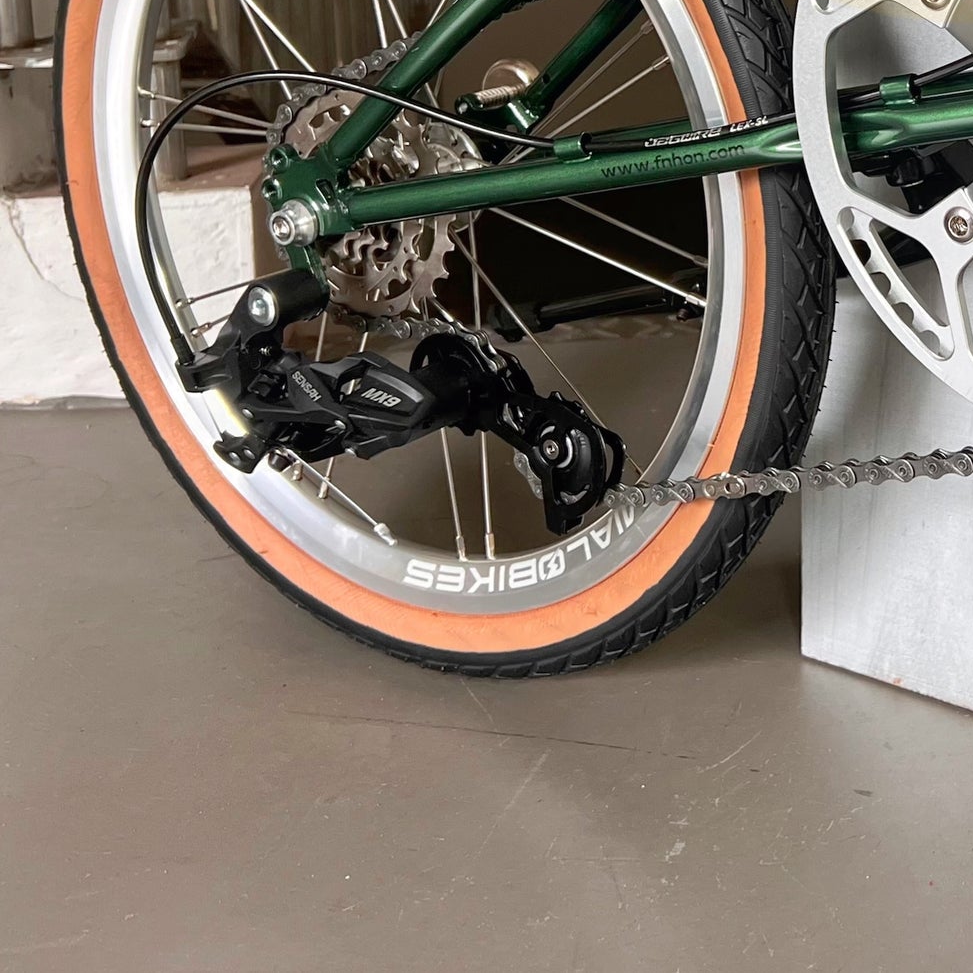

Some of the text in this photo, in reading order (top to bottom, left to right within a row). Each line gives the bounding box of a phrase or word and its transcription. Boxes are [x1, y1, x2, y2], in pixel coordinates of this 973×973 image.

[729, 115, 769, 133] LEX-SL
[601, 143, 745, 178] www.fnhon.com
[291, 370, 322, 402] SENSAH
[361, 387, 401, 407] MX9
